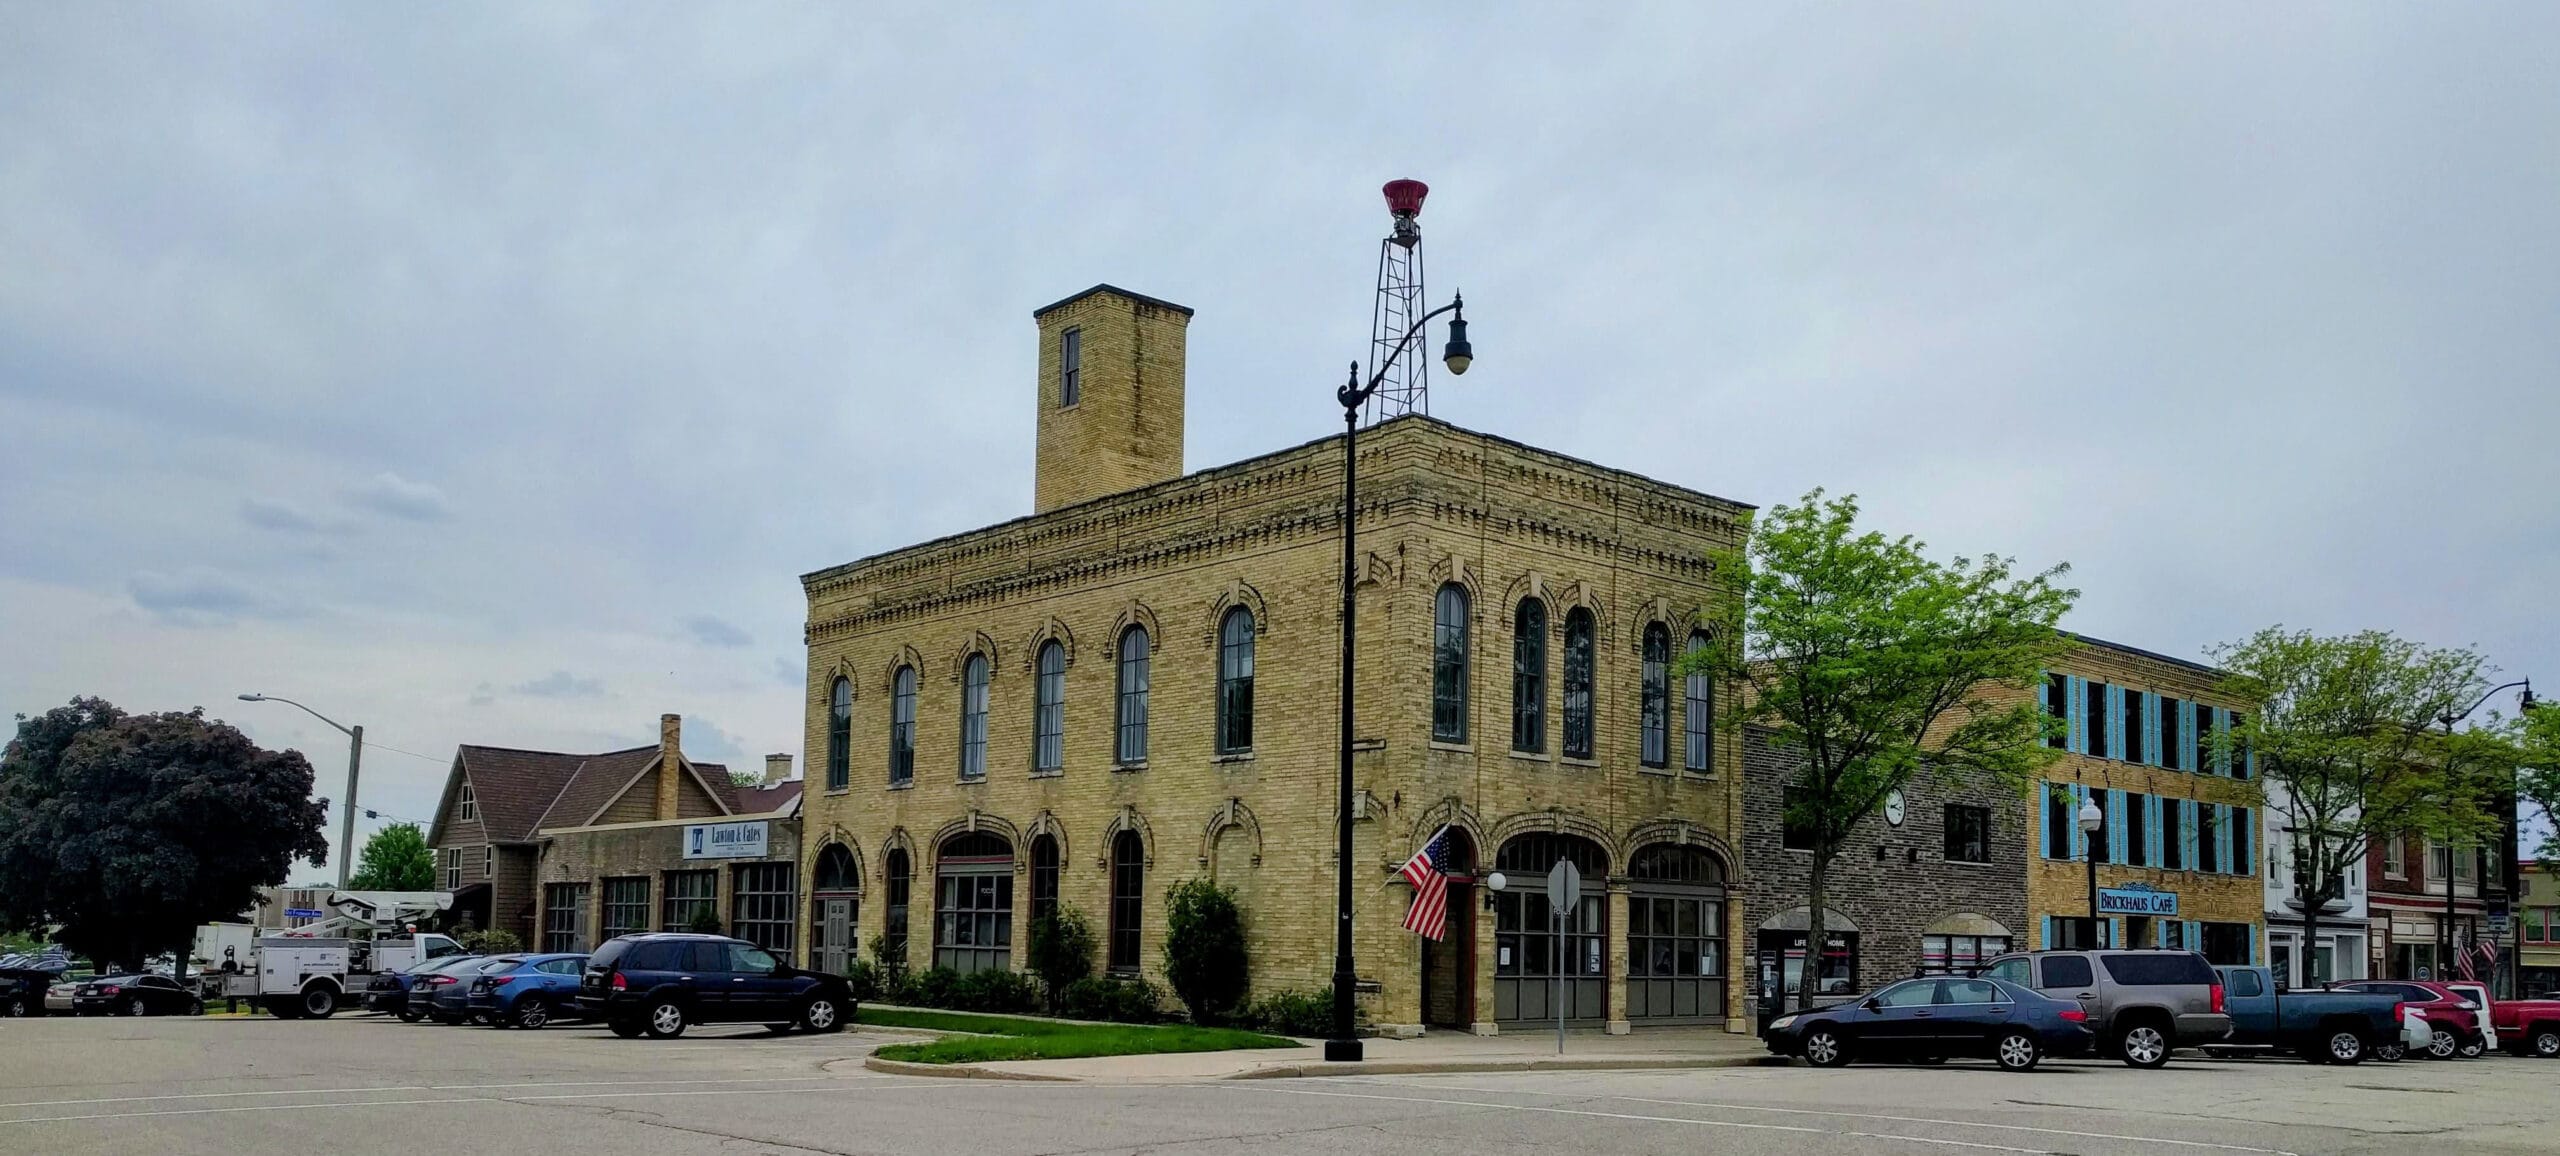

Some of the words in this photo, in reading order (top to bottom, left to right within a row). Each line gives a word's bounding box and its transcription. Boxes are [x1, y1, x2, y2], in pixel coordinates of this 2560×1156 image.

[712, 826, 735, 843] Lawton
[736, 827, 741, 842] &
[2101, 892, 2148, 911] BRICKHAUS
[2151, 895, 2173, 912] CAFÉ
[1794, 939, 1807, 947] LIFE
[1827, 939, 1845, 947] HOME
